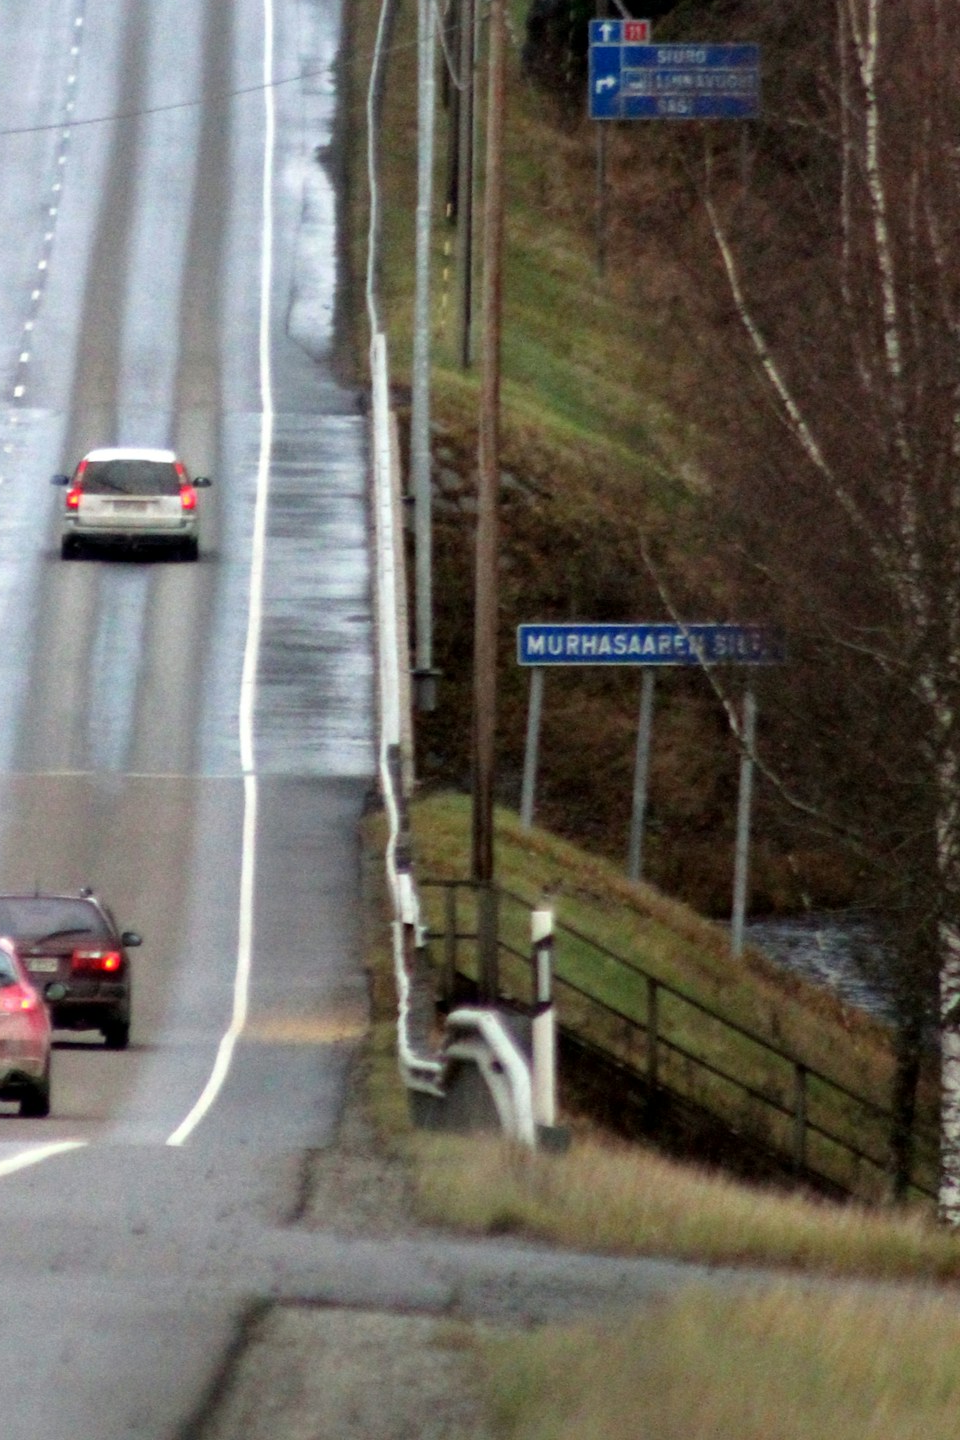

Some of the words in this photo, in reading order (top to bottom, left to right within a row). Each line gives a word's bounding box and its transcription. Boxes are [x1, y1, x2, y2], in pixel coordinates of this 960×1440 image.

[656, 49, 706, 64] SIURO
[527, 634, 704, 656] MURHASAAREN
[713, 634, 770, 656] SIL
